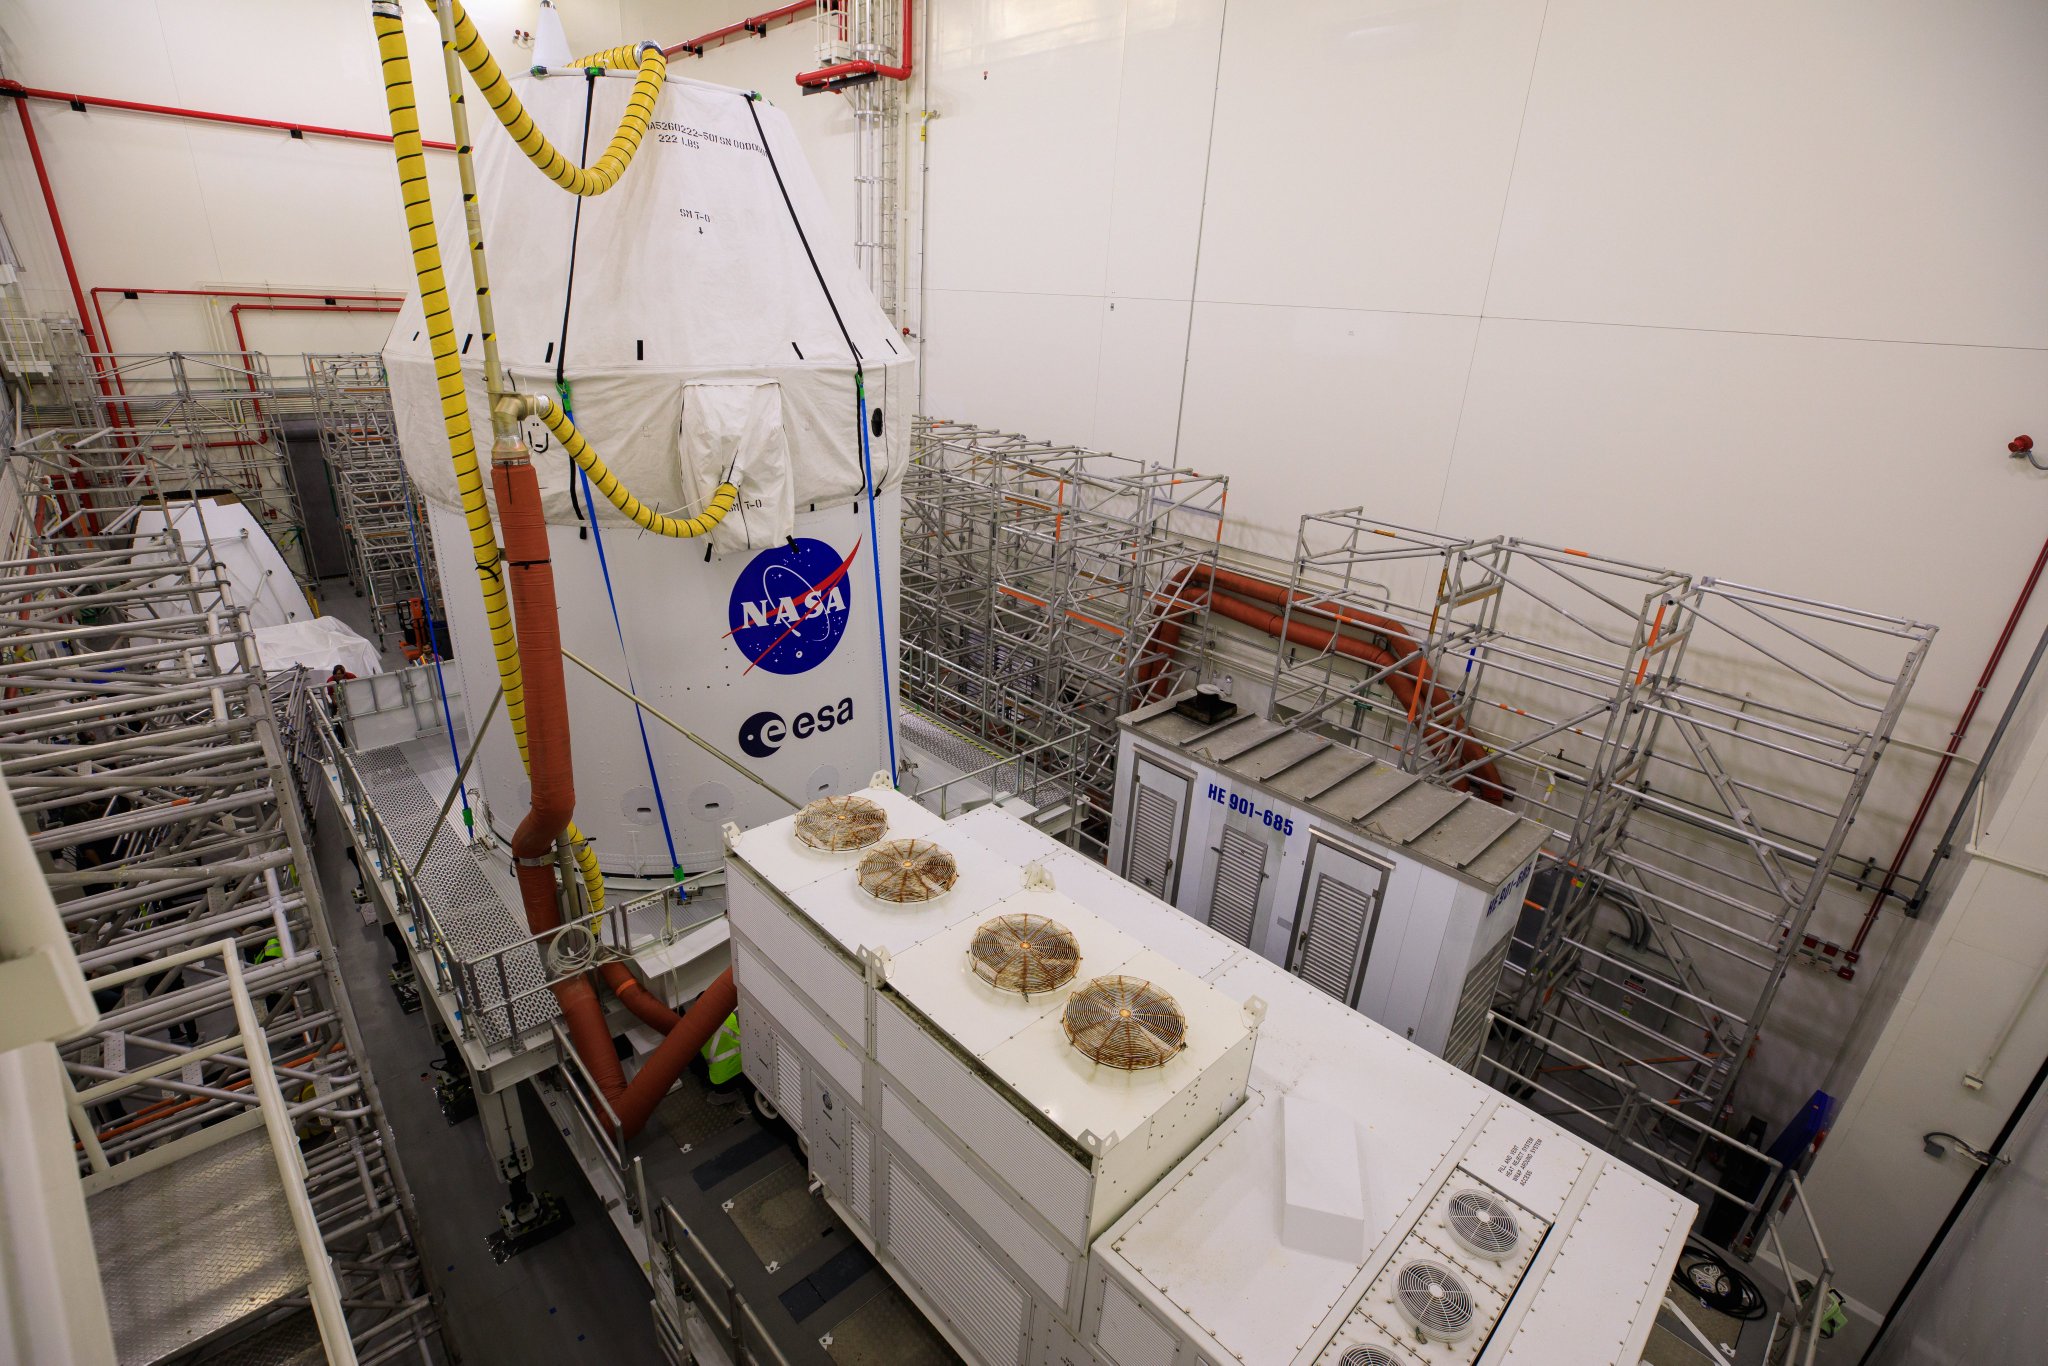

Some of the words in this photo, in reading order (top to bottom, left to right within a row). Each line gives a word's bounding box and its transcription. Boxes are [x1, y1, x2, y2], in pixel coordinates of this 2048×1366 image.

[658, 133, 678, 143] 222
[681, 136, 700, 150] LBS
[719, 137, 732, 147] SN
[694, 211, 711, 223] T-0
[740, 586, 847, 629] NASA
[792, 697, 854, 739] esa
[1207, 783, 1226, 805] HE
[1228, 793, 1294, 836] 901-685
[1530, 1138, 1543, 1154] SYSTEM
[1497, 1164, 1507, 1173] FILL
[1504, 1154, 1513, 1165] AND
[1505, 1166, 1515, 1178] HEAT
[1522, 1136, 1534, 1152] SYSTEM
[1519, 1170, 1533, 1187] ACCESS
